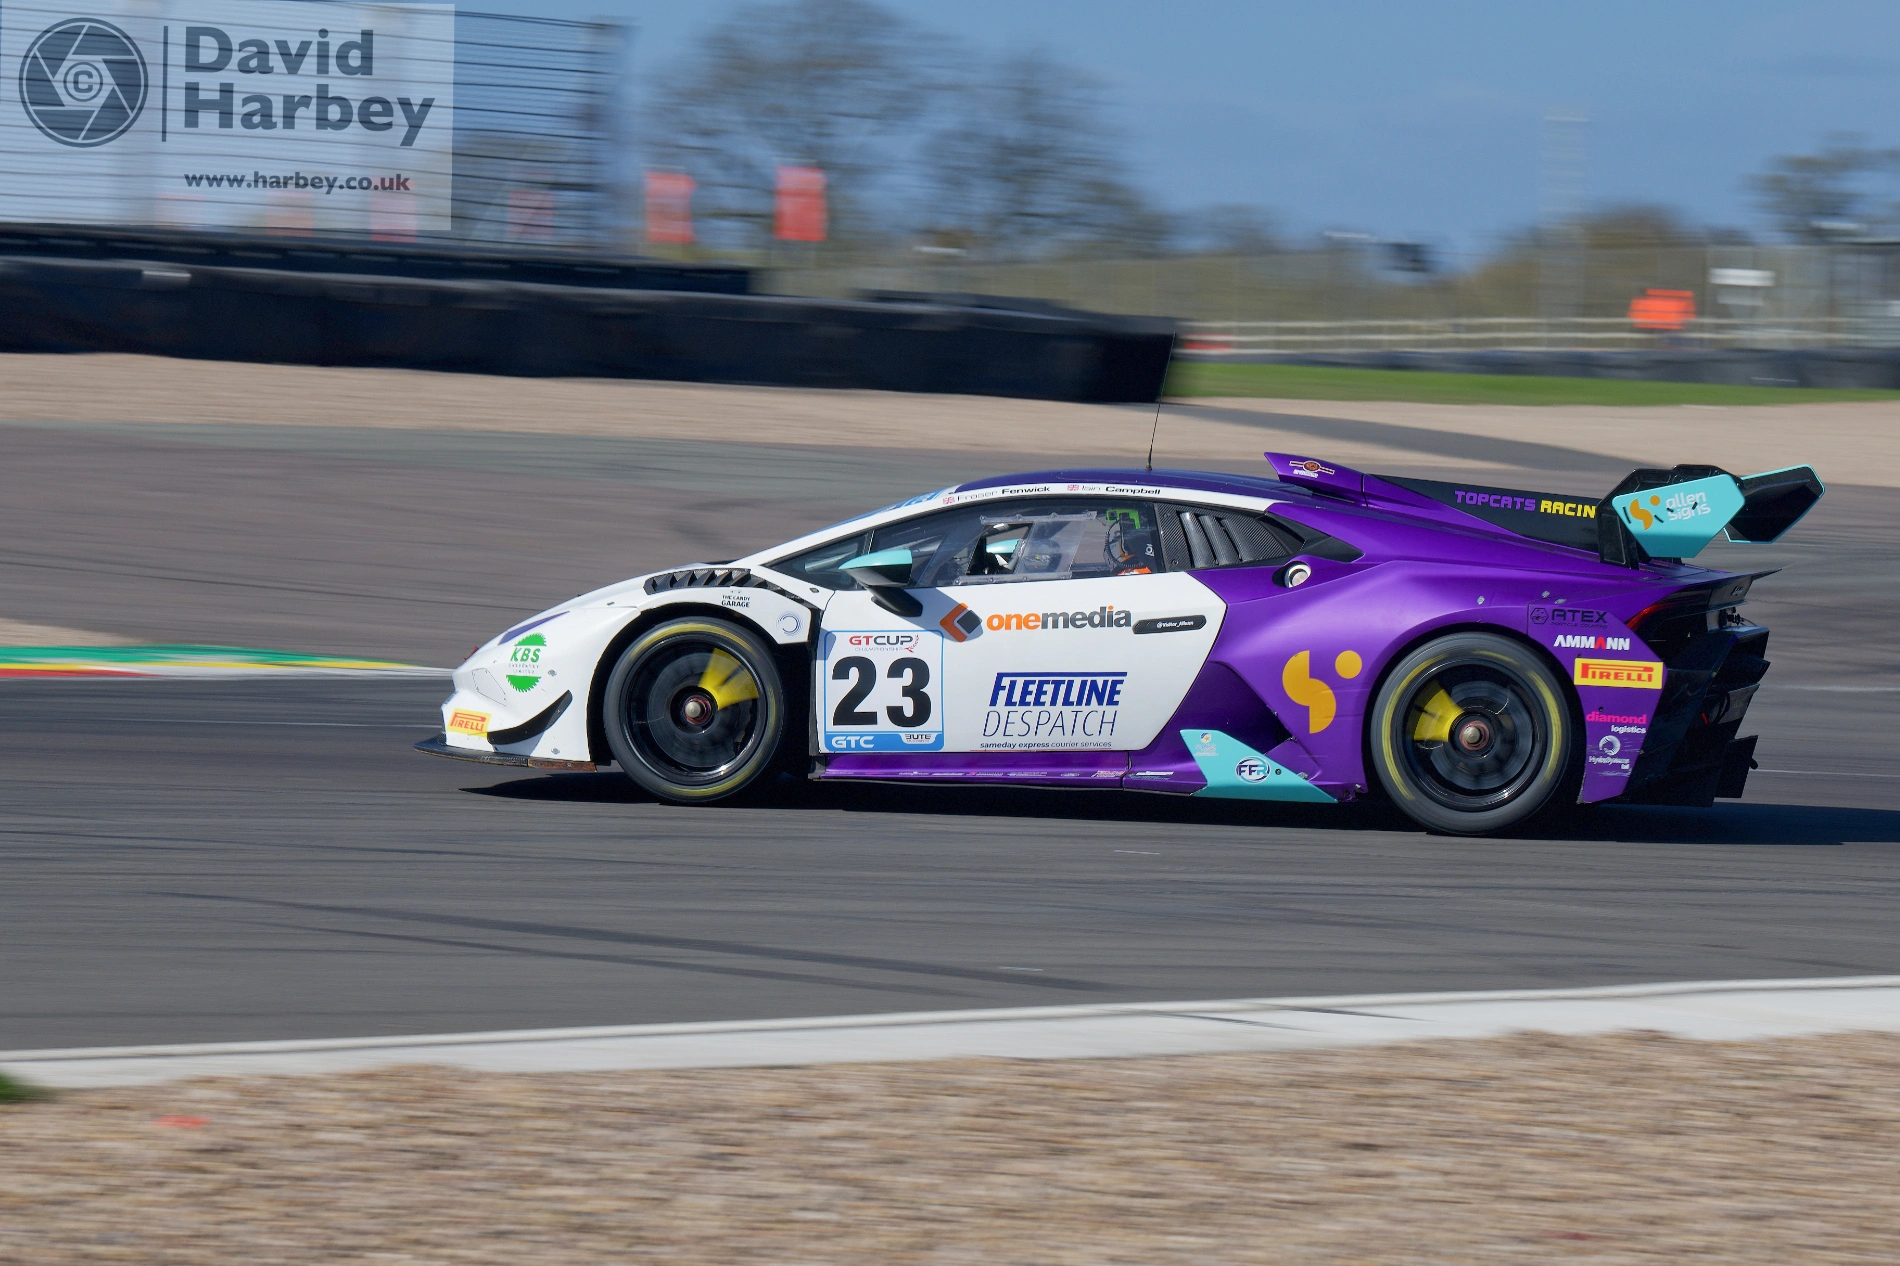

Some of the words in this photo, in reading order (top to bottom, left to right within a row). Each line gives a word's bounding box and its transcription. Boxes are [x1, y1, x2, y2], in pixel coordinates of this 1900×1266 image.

[1001, 486, 1051, 495] Fenwick
[1105, 486, 1161, 495] Campbell
[1454, 490, 1536, 511] TOPCATS
[1540, 500, 1597, 518] RACIN
[1665, 492, 1707, 509] allen
[1667, 503, 1711, 521] signs
[986, 605, 1132, 631] onemedia
[1551, 609, 1608, 623] ATEX
[1553, 634, 1631, 650] AMMANN
[510, 647, 541, 662] KBS
[1580, 662, 1654, 683] PIRELLI
[831, 655, 932, 728] 23
[989, 672, 1128, 706] FLEETLINE
[450, 712, 487, 732] PIRELLI
[982, 710, 1118, 737] DESPATCH
[1586, 711, 1647, 725] diamond
[1611, 725, 1647, 734] logistics
[831, 735, 875, 748] GTC
[980, 741, 1017, 749] sameday
[1018, 741, 1050, 749] express
[1080, 740, 1112, 748] services
